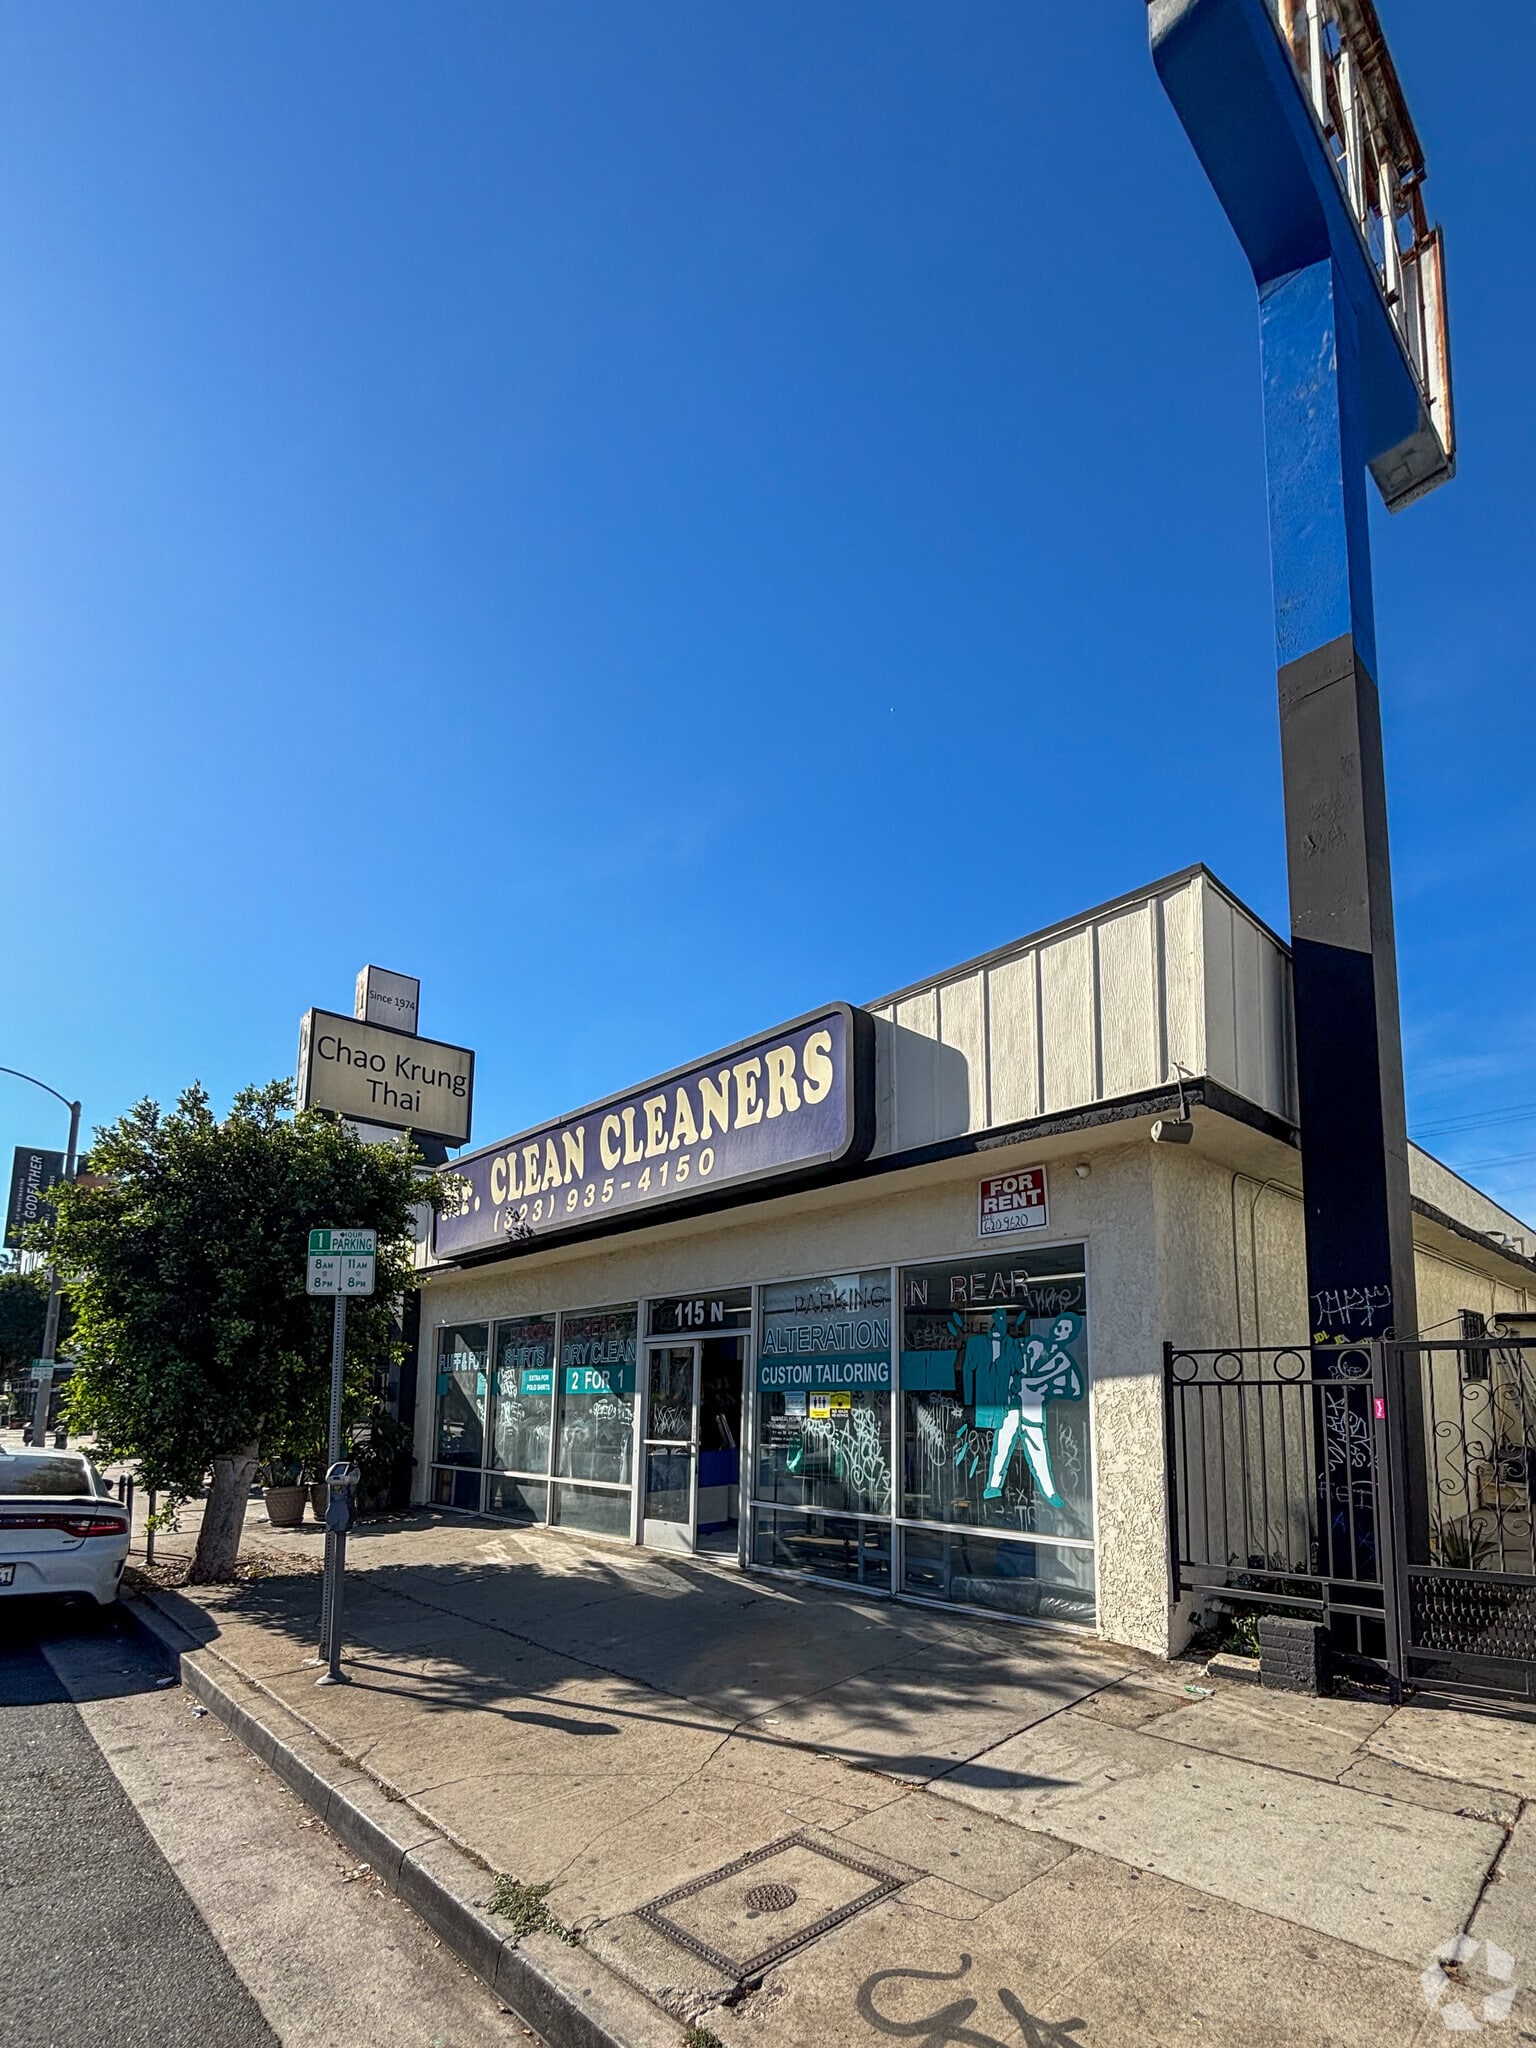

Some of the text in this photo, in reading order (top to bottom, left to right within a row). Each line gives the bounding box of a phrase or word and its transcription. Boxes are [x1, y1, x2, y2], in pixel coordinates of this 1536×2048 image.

[369, 989, 415, 1011] Since 1974
[317, 1035, 467, 1097] Chao Krung
[366, 1078, 421, 1112] Thai
[490, 1125, 585, 1206] CLEAN
[600, 1029, 834, 1171] CLEANERS
[24, 1154, 43, 1219] GODFATHER
[493, 1147, 715, 1233] (323) 935-4150
[990, 1174, 1033, 1197] FOR
[983, 1188, 1041, 1213] RENT
[318, 1232, 324, 1248] 1
[332, 1238, 372, 1250] PARKING
[795, 1286, 885, 1315] PARKING
[904, 1280, 928, 1307] IN
[950, 1270, 1029, 1302] REAR
[675, 1300, 723, 1327] 115 N
[762, 1319, 890, 1354] ALTERATION
[505, 1347, 545, 1367] SHIRTS
[562, 1339, 637, 1366] DRY CLEAN
[571, 1369, 623, 1390] 2 FOR 1
[761, 1362, 889, 1384] CUSTOM TAILORING
